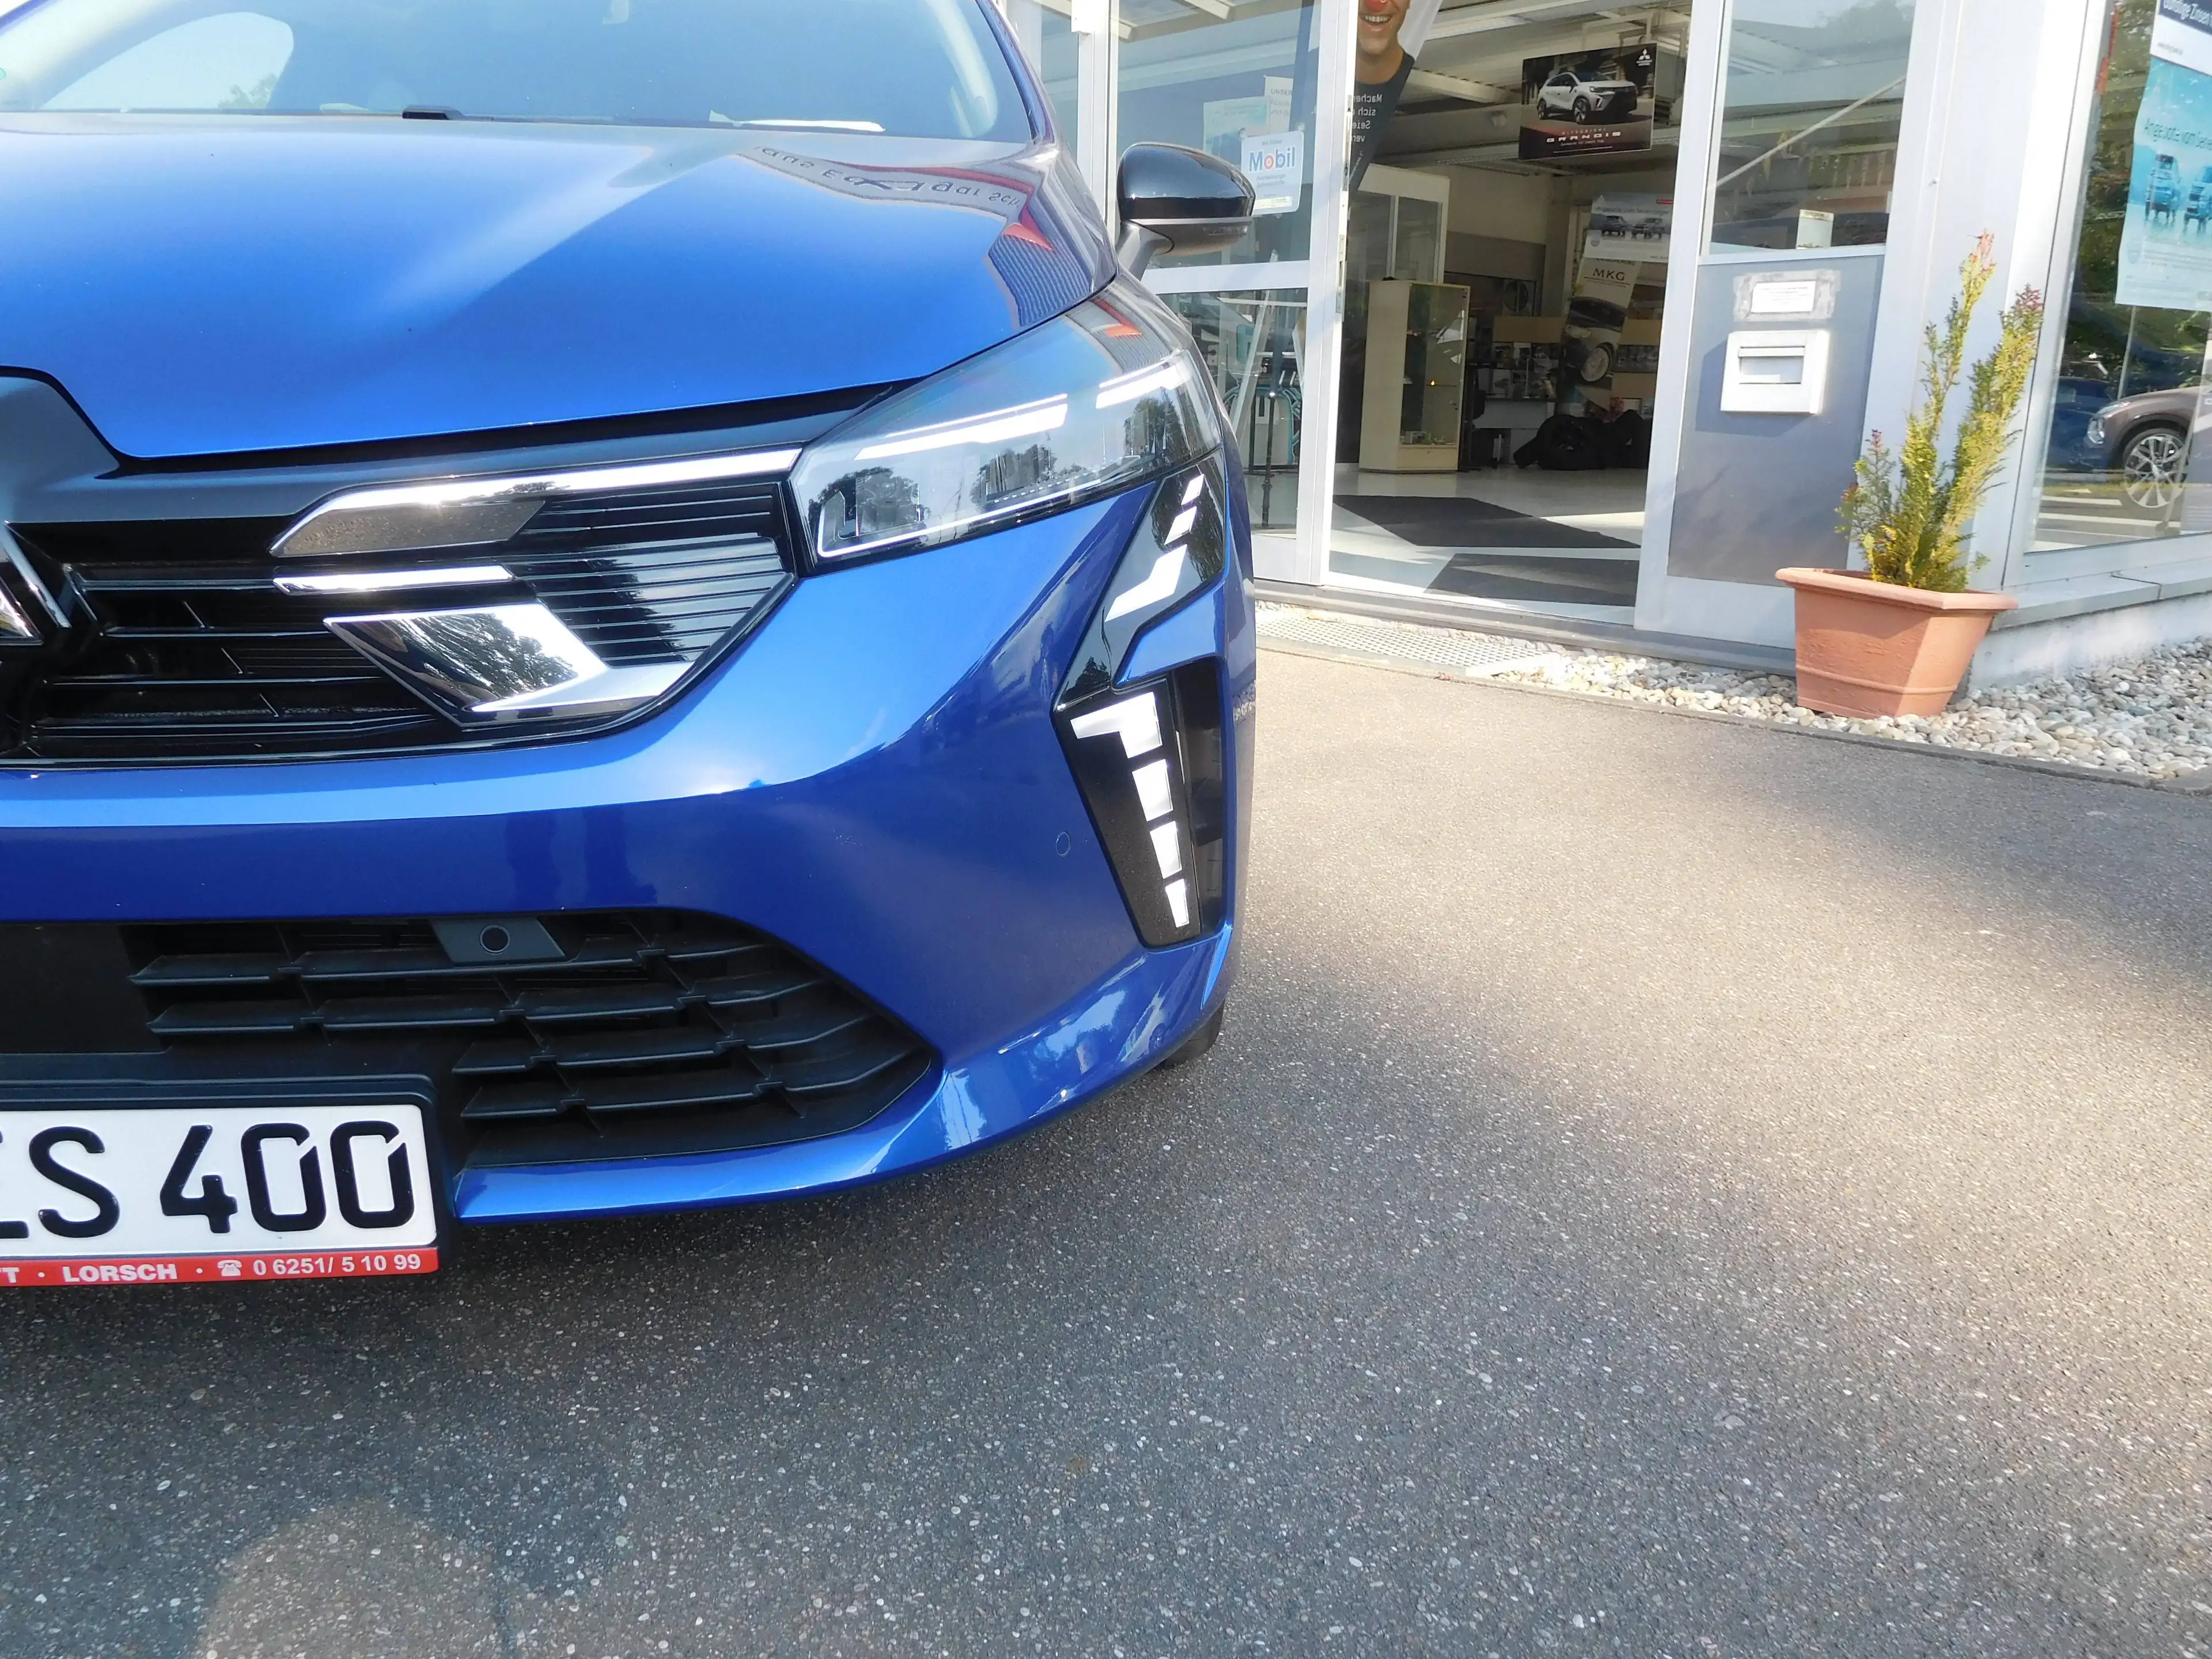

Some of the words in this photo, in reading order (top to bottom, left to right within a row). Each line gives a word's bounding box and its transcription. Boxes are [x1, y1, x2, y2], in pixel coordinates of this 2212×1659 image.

[1546, 131, 1621, 143] GRANDIS
[1249, 146, 1296, 172] Mobil
[1592, 268, 1625, 281] MKG
[0, 1126, 120, 1238] S
[160, 1120, 415, 1234] 400
[0, 1267, 20, 1283] T
[62, 1263, 178, 1283] LORSCH
[253, 1259, 266, 1275] 0
[272, 1256, 334, 1275] 6251/
[341, 1256, 355, 1272] 5
[361, 1255, 387, 1271] 10
[393, 1253, 421, 1271] 99
